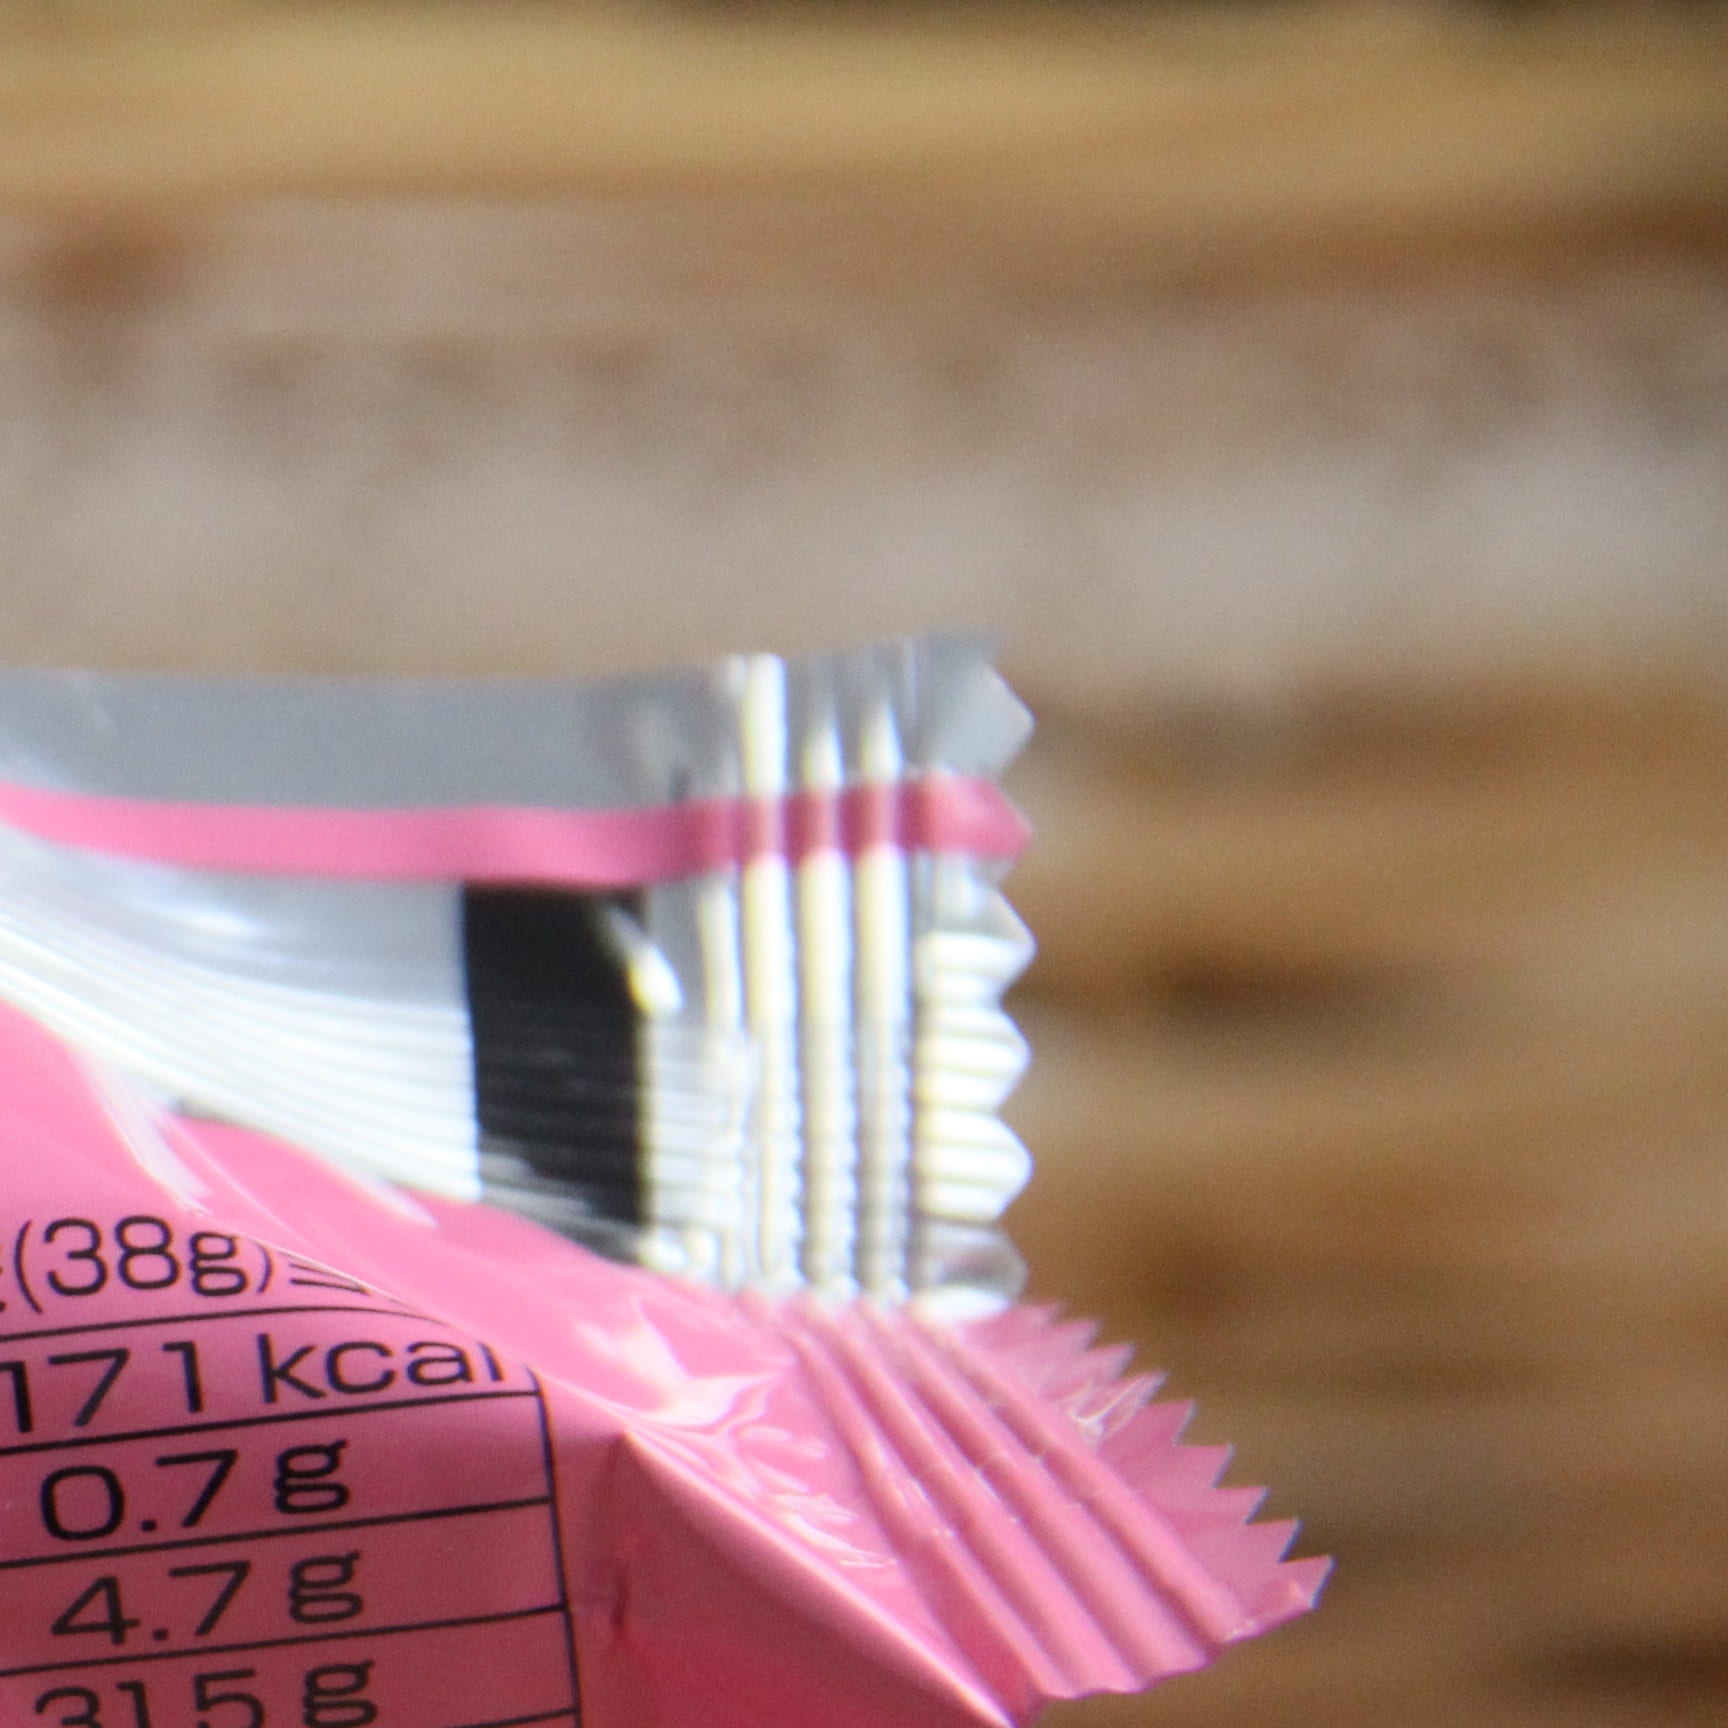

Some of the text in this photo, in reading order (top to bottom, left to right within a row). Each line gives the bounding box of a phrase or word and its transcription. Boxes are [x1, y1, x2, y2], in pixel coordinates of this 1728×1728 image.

[260, 1333, 505, 1404] kcal
[41, 1450, 234, 1544] 0.7
[275, 1437, 351, 1515] g
[50, 1560, 250, 1650] 4.7
[288, 1546, 365, 1623] g
